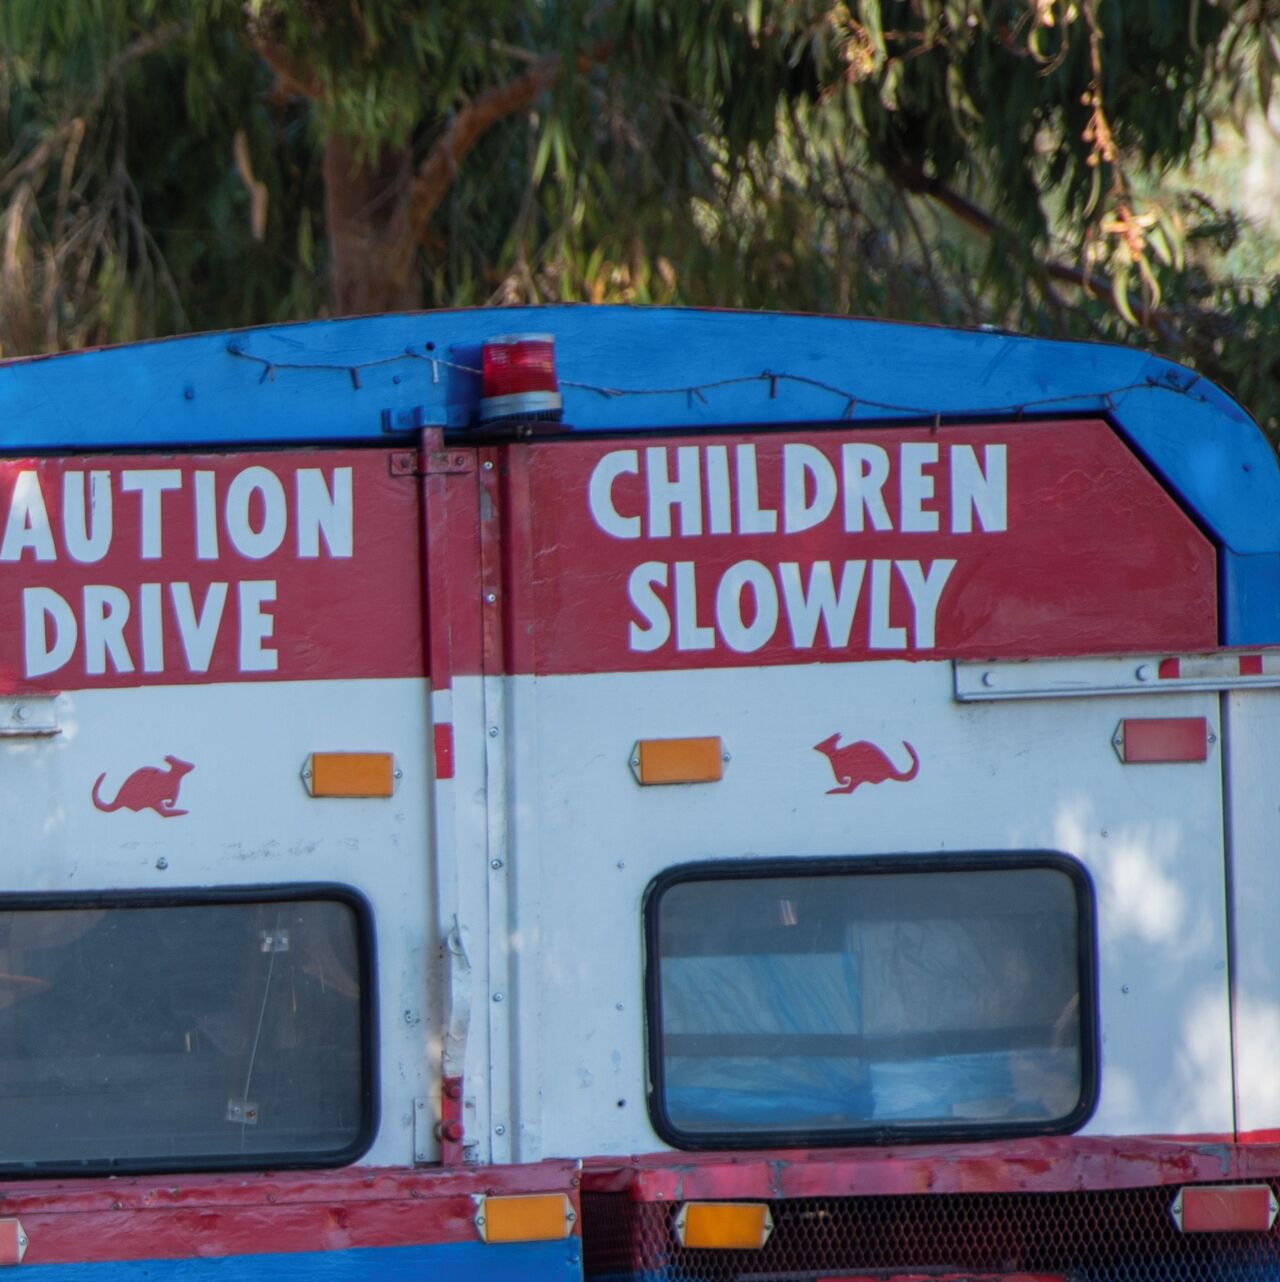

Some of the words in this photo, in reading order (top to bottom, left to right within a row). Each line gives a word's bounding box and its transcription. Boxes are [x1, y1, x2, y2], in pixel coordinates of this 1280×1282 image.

[588, 441, 1008, 540] CHILDREN
[22, 580, 277, 679] DRIVE
[627, 557, 958, 654] SLOWLY
